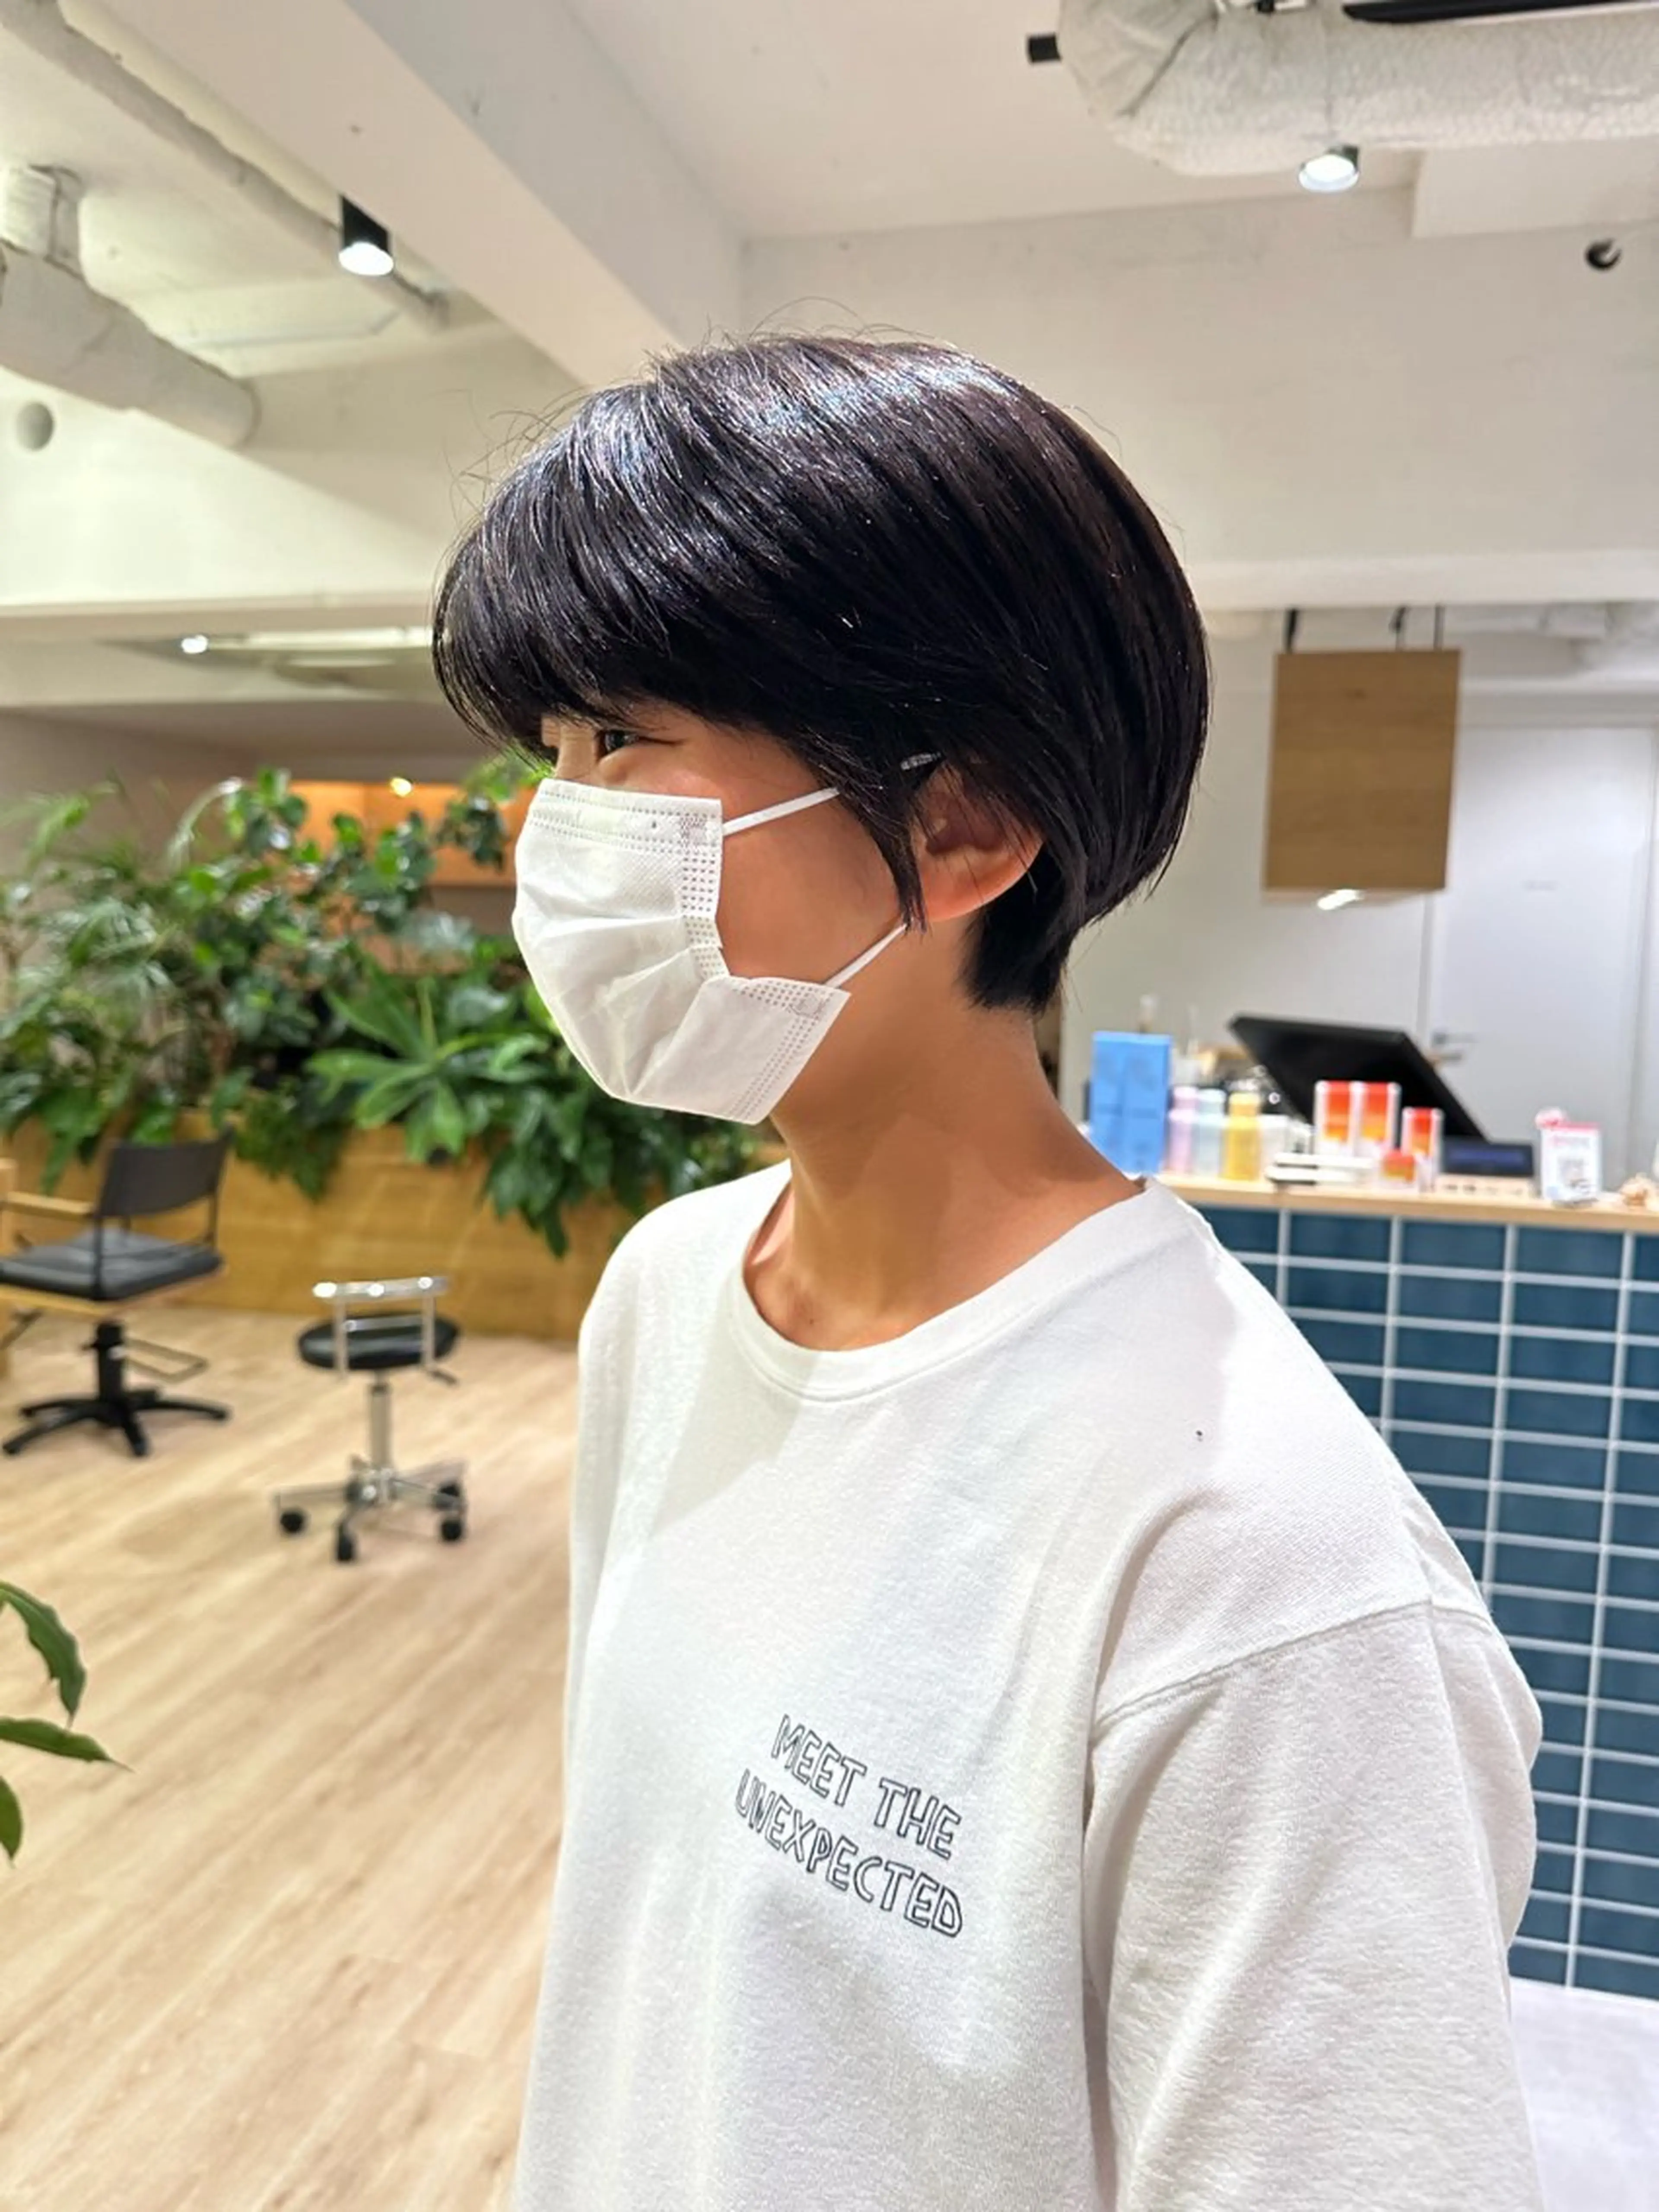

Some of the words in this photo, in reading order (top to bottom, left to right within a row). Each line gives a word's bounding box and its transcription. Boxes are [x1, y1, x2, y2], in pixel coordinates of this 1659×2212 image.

[735, 1769, 963, 1938] UNEXPECTED
[771, 1714, 867, 1807] MEET
[874, 1777, 962, 1859] THE
